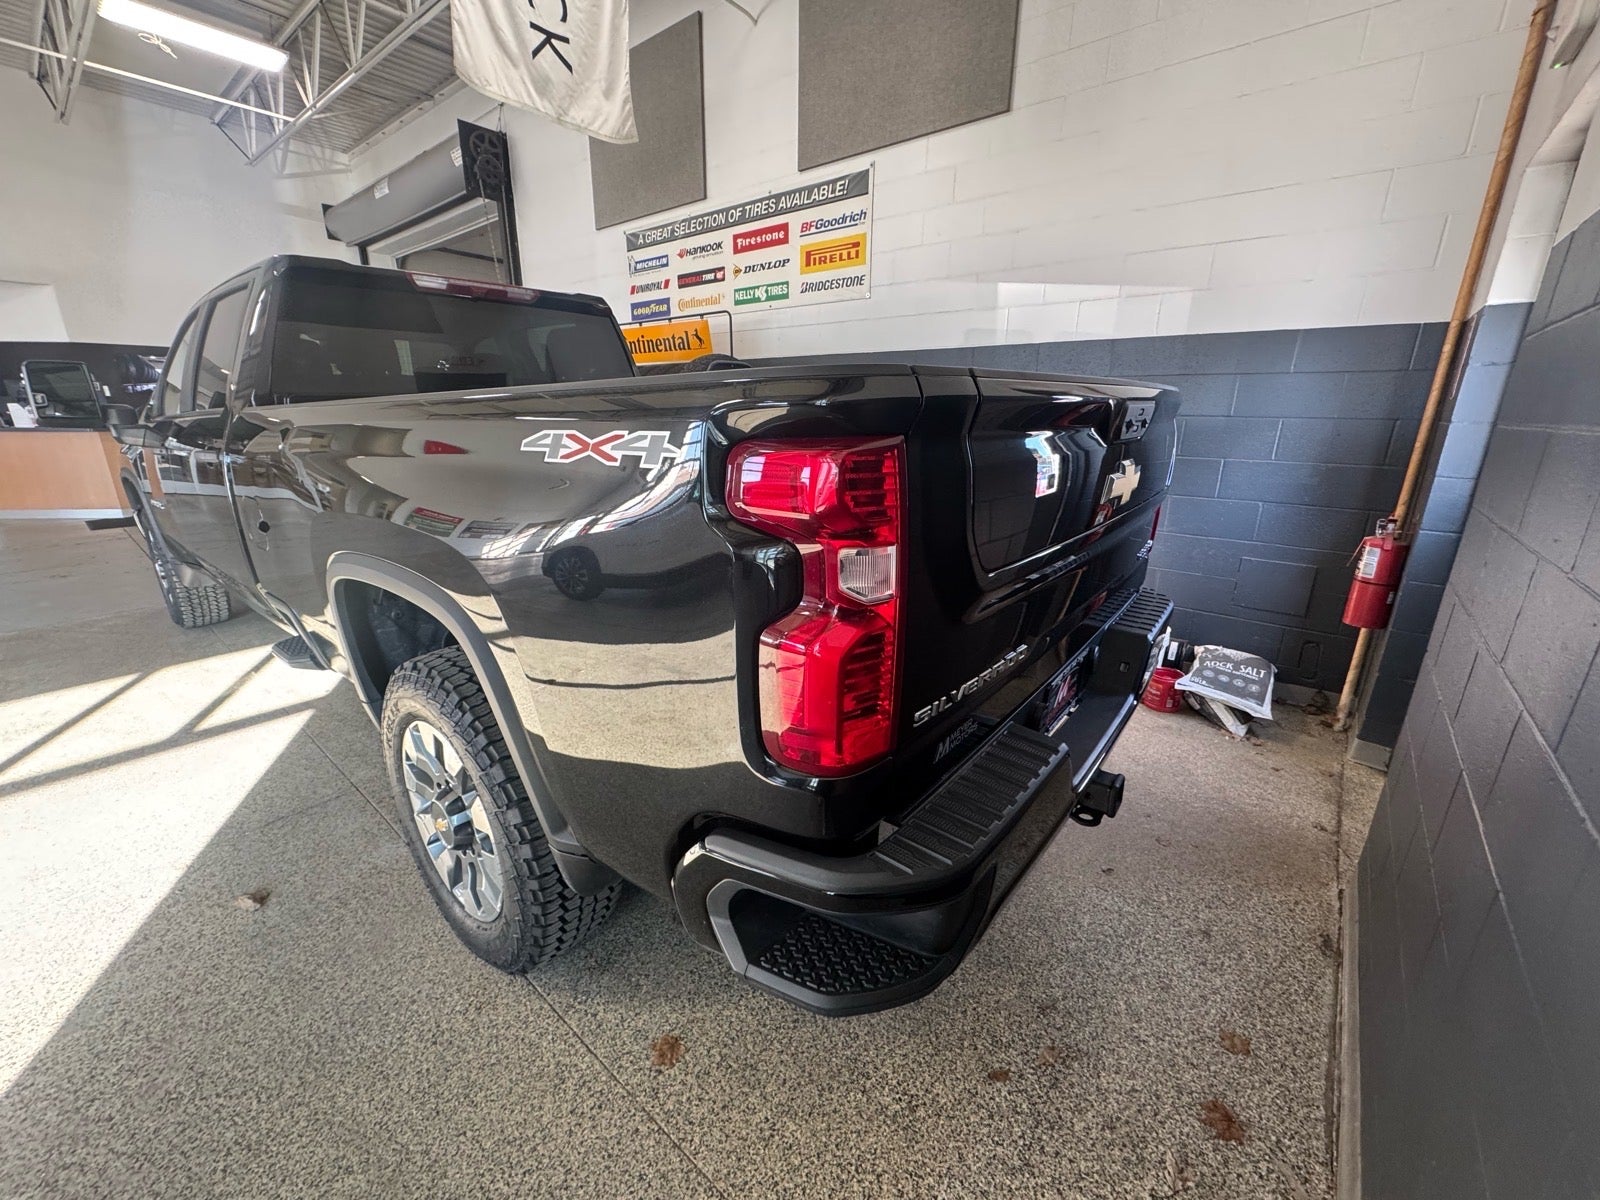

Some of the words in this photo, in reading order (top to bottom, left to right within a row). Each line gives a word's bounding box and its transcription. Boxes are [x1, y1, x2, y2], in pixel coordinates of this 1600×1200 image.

[638, 234, 645, 245] A
[645, 227, 672, 243] GREAT
[674, 212, 726, 237] SELECTION
[728, 208, 744, 226] OF
[744, 198, 776, 219] TIRES
[777, 179, 849, 212] AVAILABLE!
[800, 209, 867, 234] BFGoodrich
[736, 230, 785, 250] Firestone
[636, 256, 668, 270] MICHELIN
[804, 240, 861, 268] PIRELLI
[743, 258, 790, 274] DUNLOP
[635, 280, 664, 294] UNIROYAL
[735, 287, 755, 301] KELLY
[768, 284, 788, 296] TIRES
[800, 274, 866, 294] BRIDGESTONE
[633, 303, 668, 316] GOODYEAR
[678, 293, 721, 312] Continental
[629, 330, 691, 355] ntinental
[1239, 664, 1267, 679] SALT
[913, 643, 1028, 728] SILVERADO
